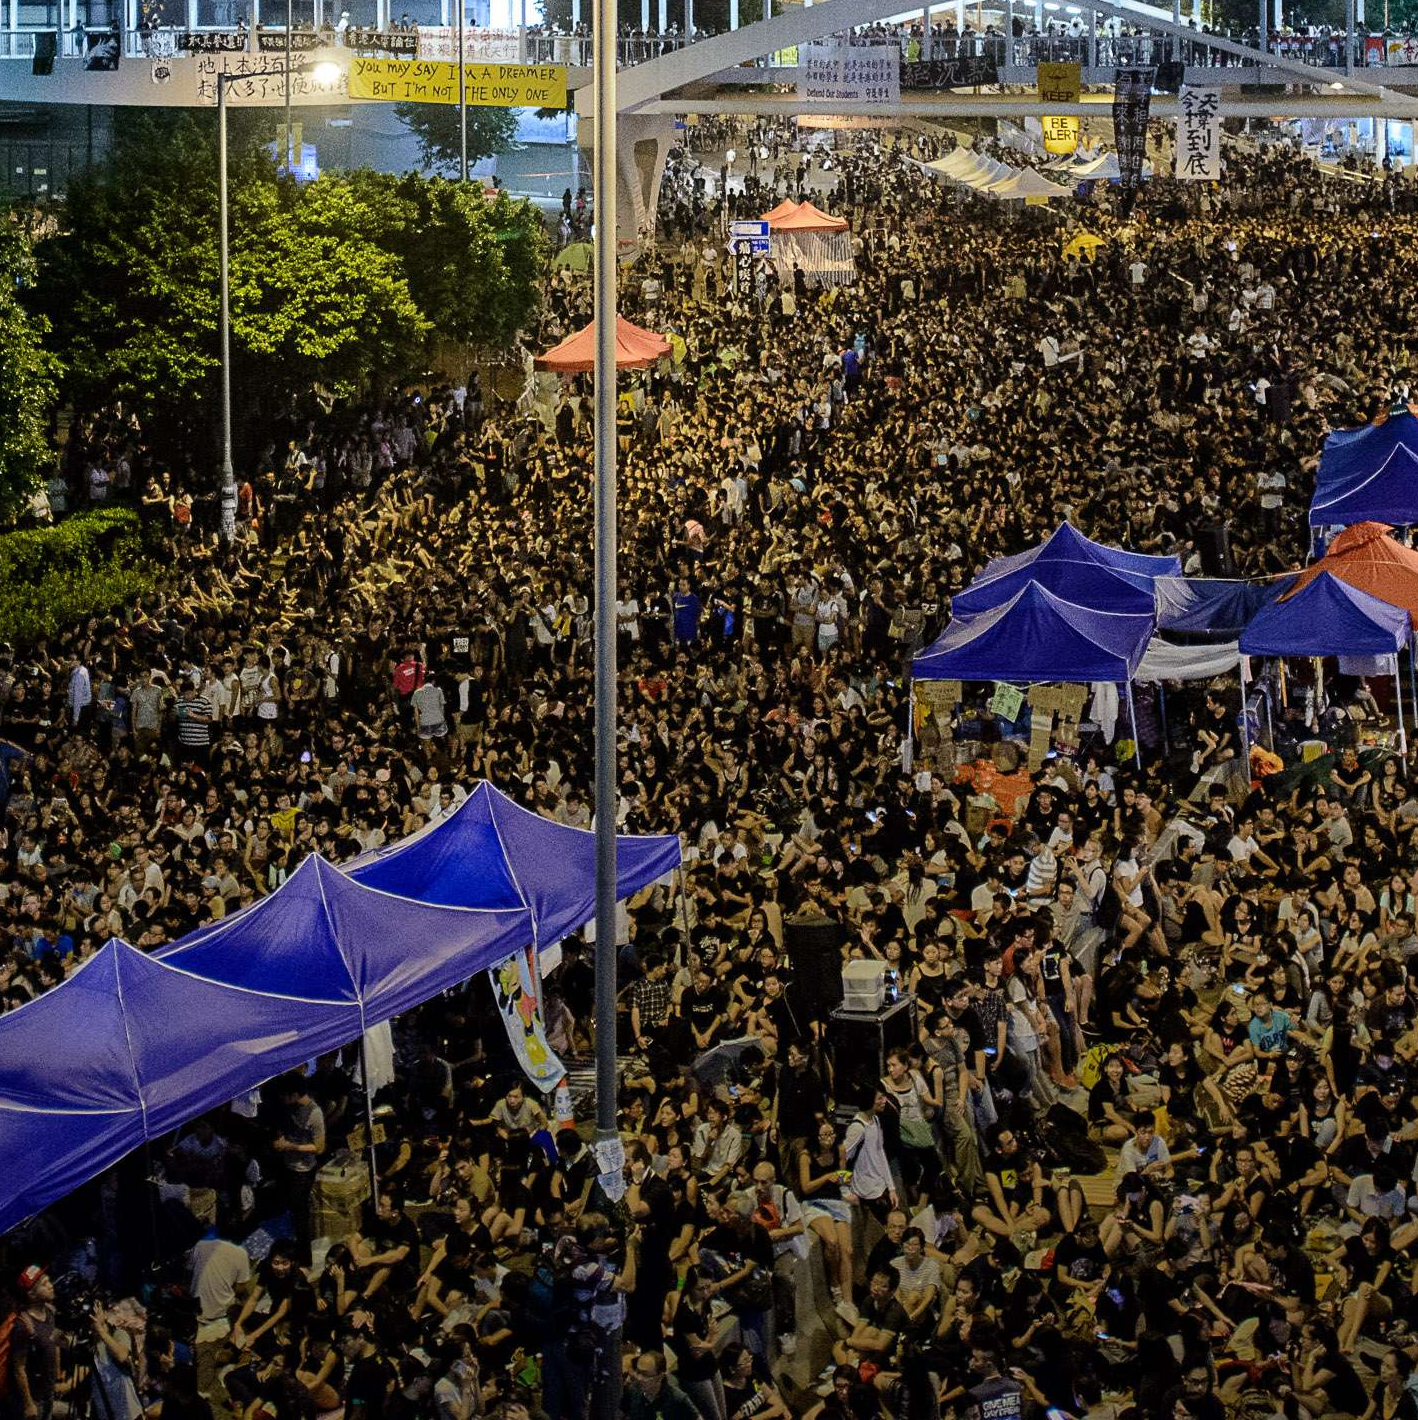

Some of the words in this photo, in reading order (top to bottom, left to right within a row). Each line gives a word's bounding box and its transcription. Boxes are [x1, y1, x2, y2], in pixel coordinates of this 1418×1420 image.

[387, 62, 411, 76] MAY
[413, 64, 439, 81] SAY
[482, 68, 491, 80] A
[499, 66, 558, 81] DREAMER
[372, 81, 395, 96] BUT
[432, 85, 453, 98] NOT
[464, 84, 489, 99] THE
[492, 87, 519, 100] ONLY
[525, 88, 549, 101] ONE
[1042, 91, 1074, 102] KEEP
[1051, 118, 1068, 129] BE
[1044, 130, 1078, 141] ALERT
